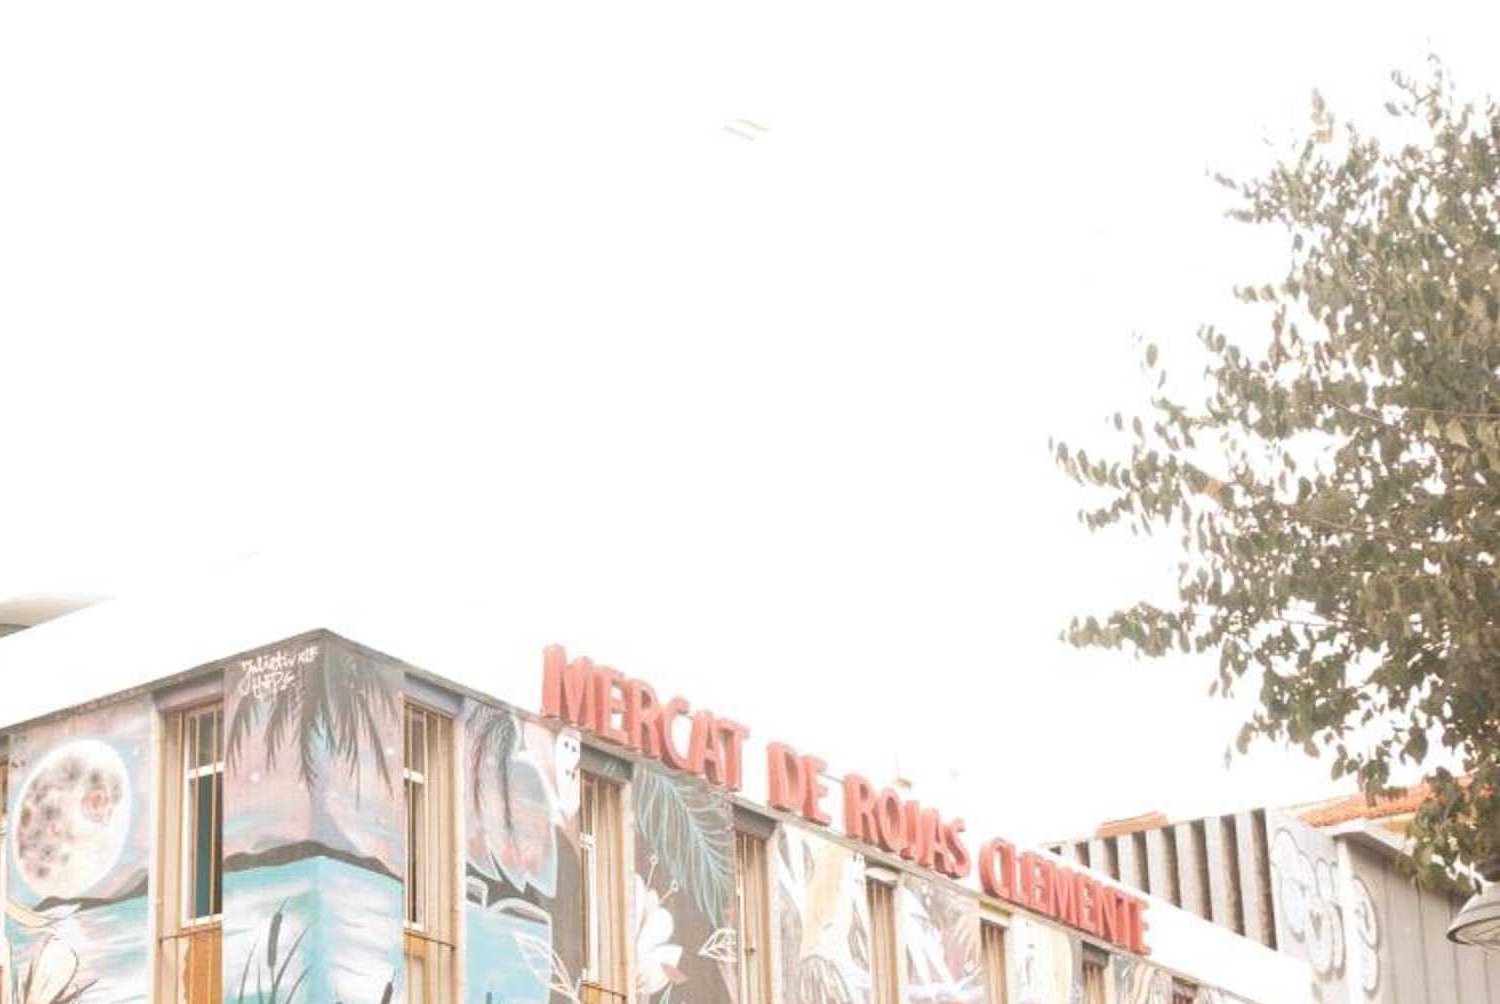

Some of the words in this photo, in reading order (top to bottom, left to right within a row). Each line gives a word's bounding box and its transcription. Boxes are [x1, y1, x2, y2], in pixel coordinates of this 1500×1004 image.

[541, 643, 750, 792] MERCAT
[766, 741, 835, 828] DE
[843, 774, 971, 879] ROJAS
[979, 837, 1152, 956] CLEMENTE
